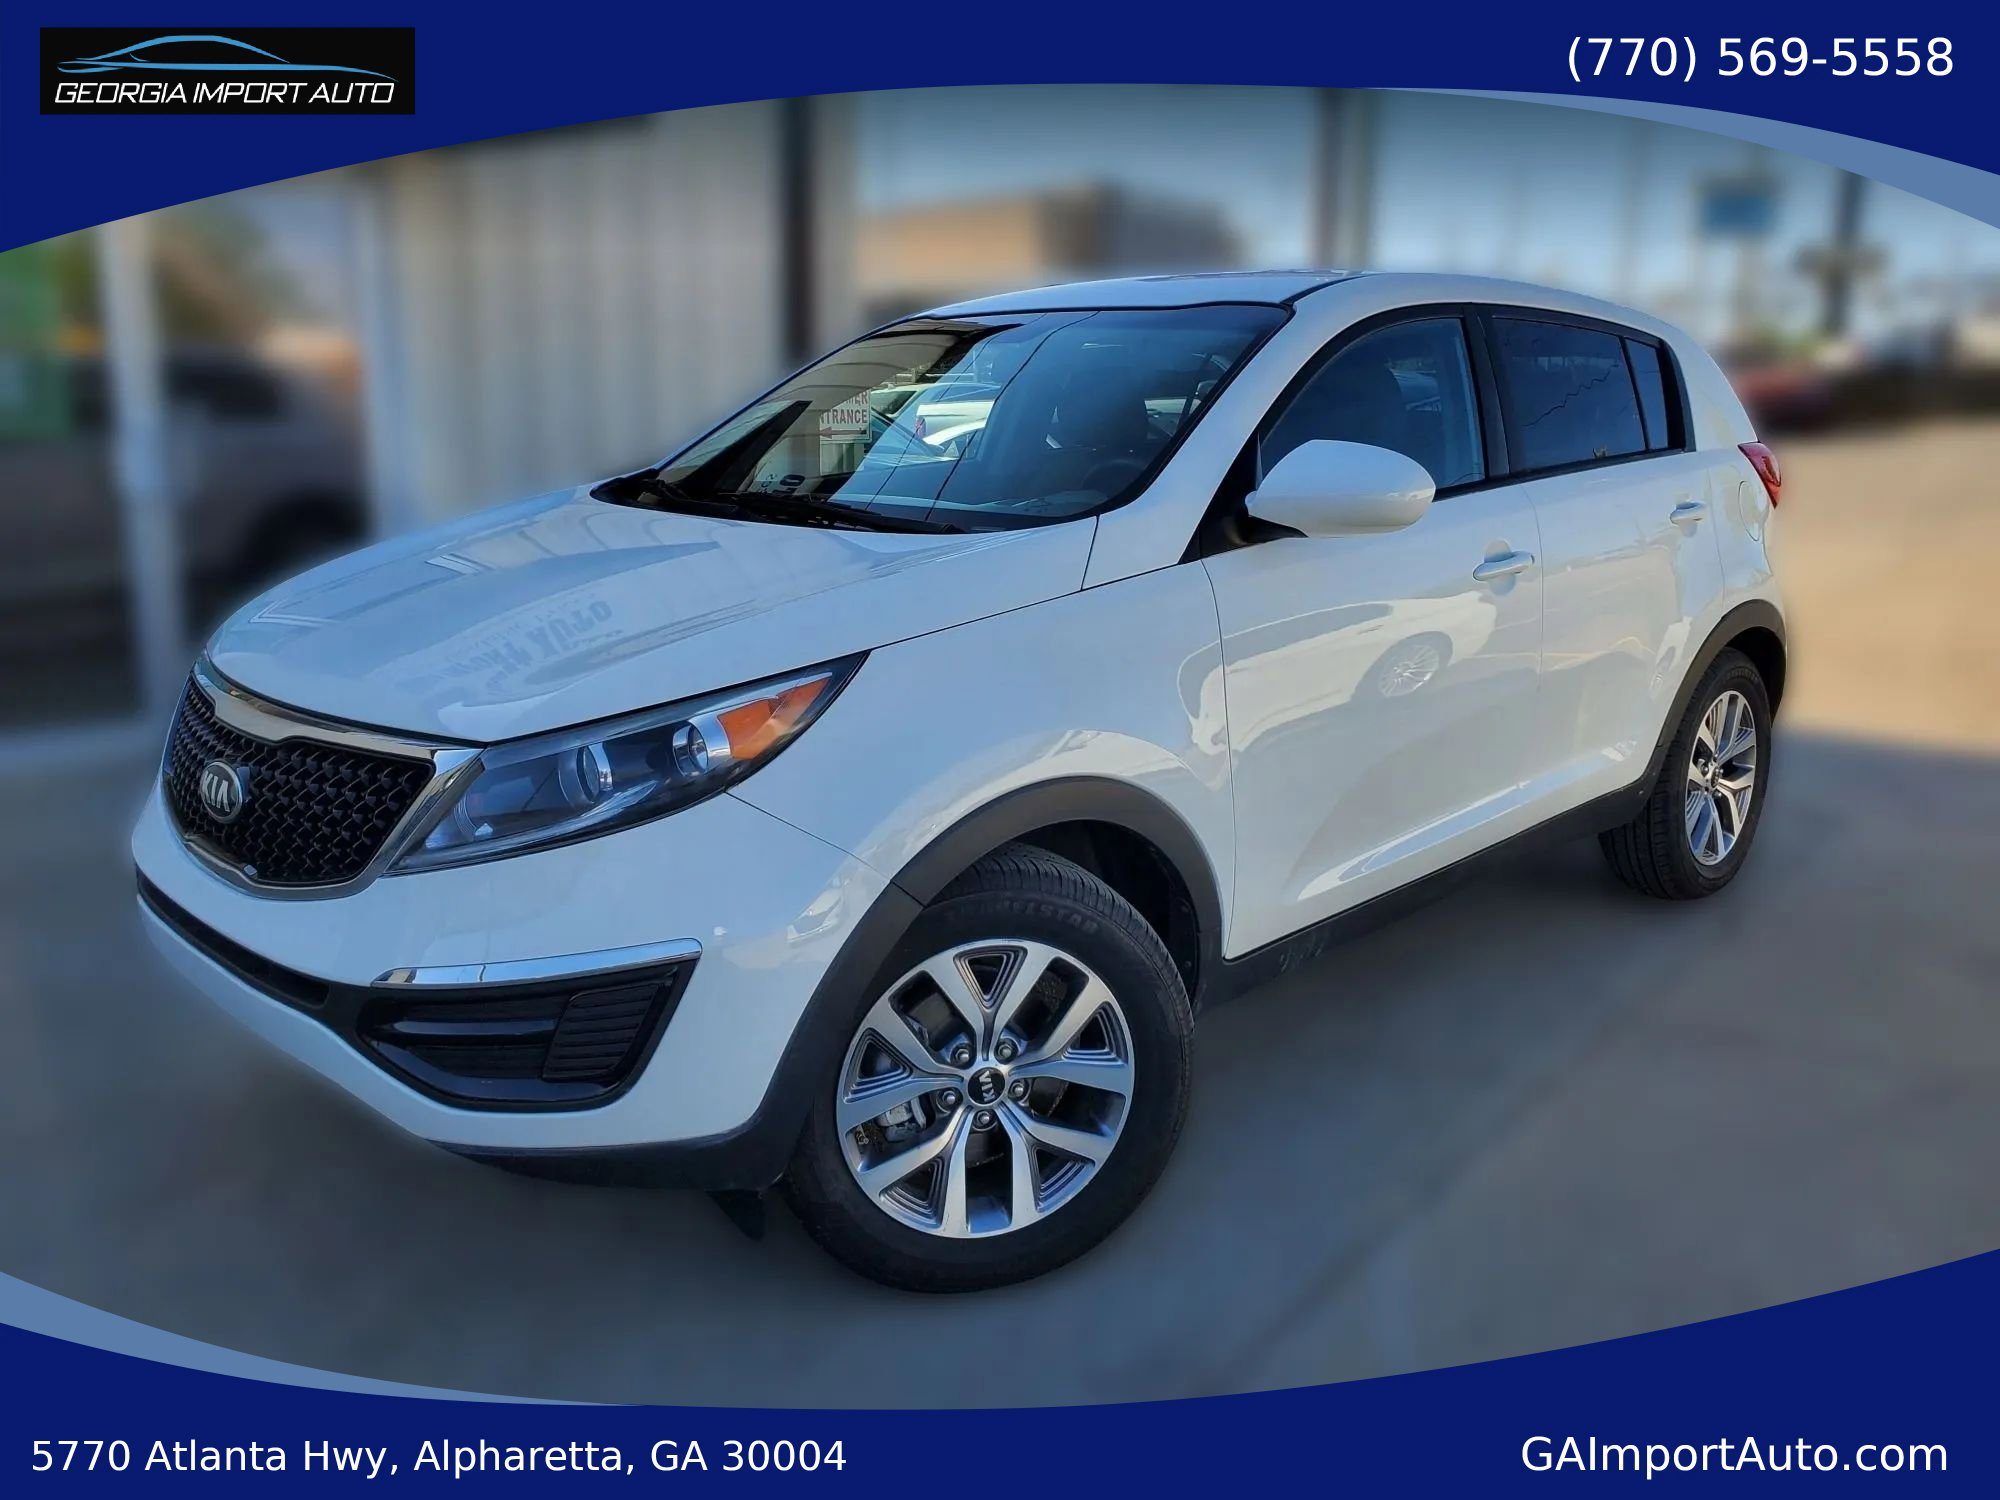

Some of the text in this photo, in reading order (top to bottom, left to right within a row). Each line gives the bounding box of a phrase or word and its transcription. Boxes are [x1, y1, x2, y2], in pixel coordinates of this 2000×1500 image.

[820, 409, 867, 424] TRANCE
[202, 769, 231, 812] KIA
[979, 1070, 996, 1102] KIA
